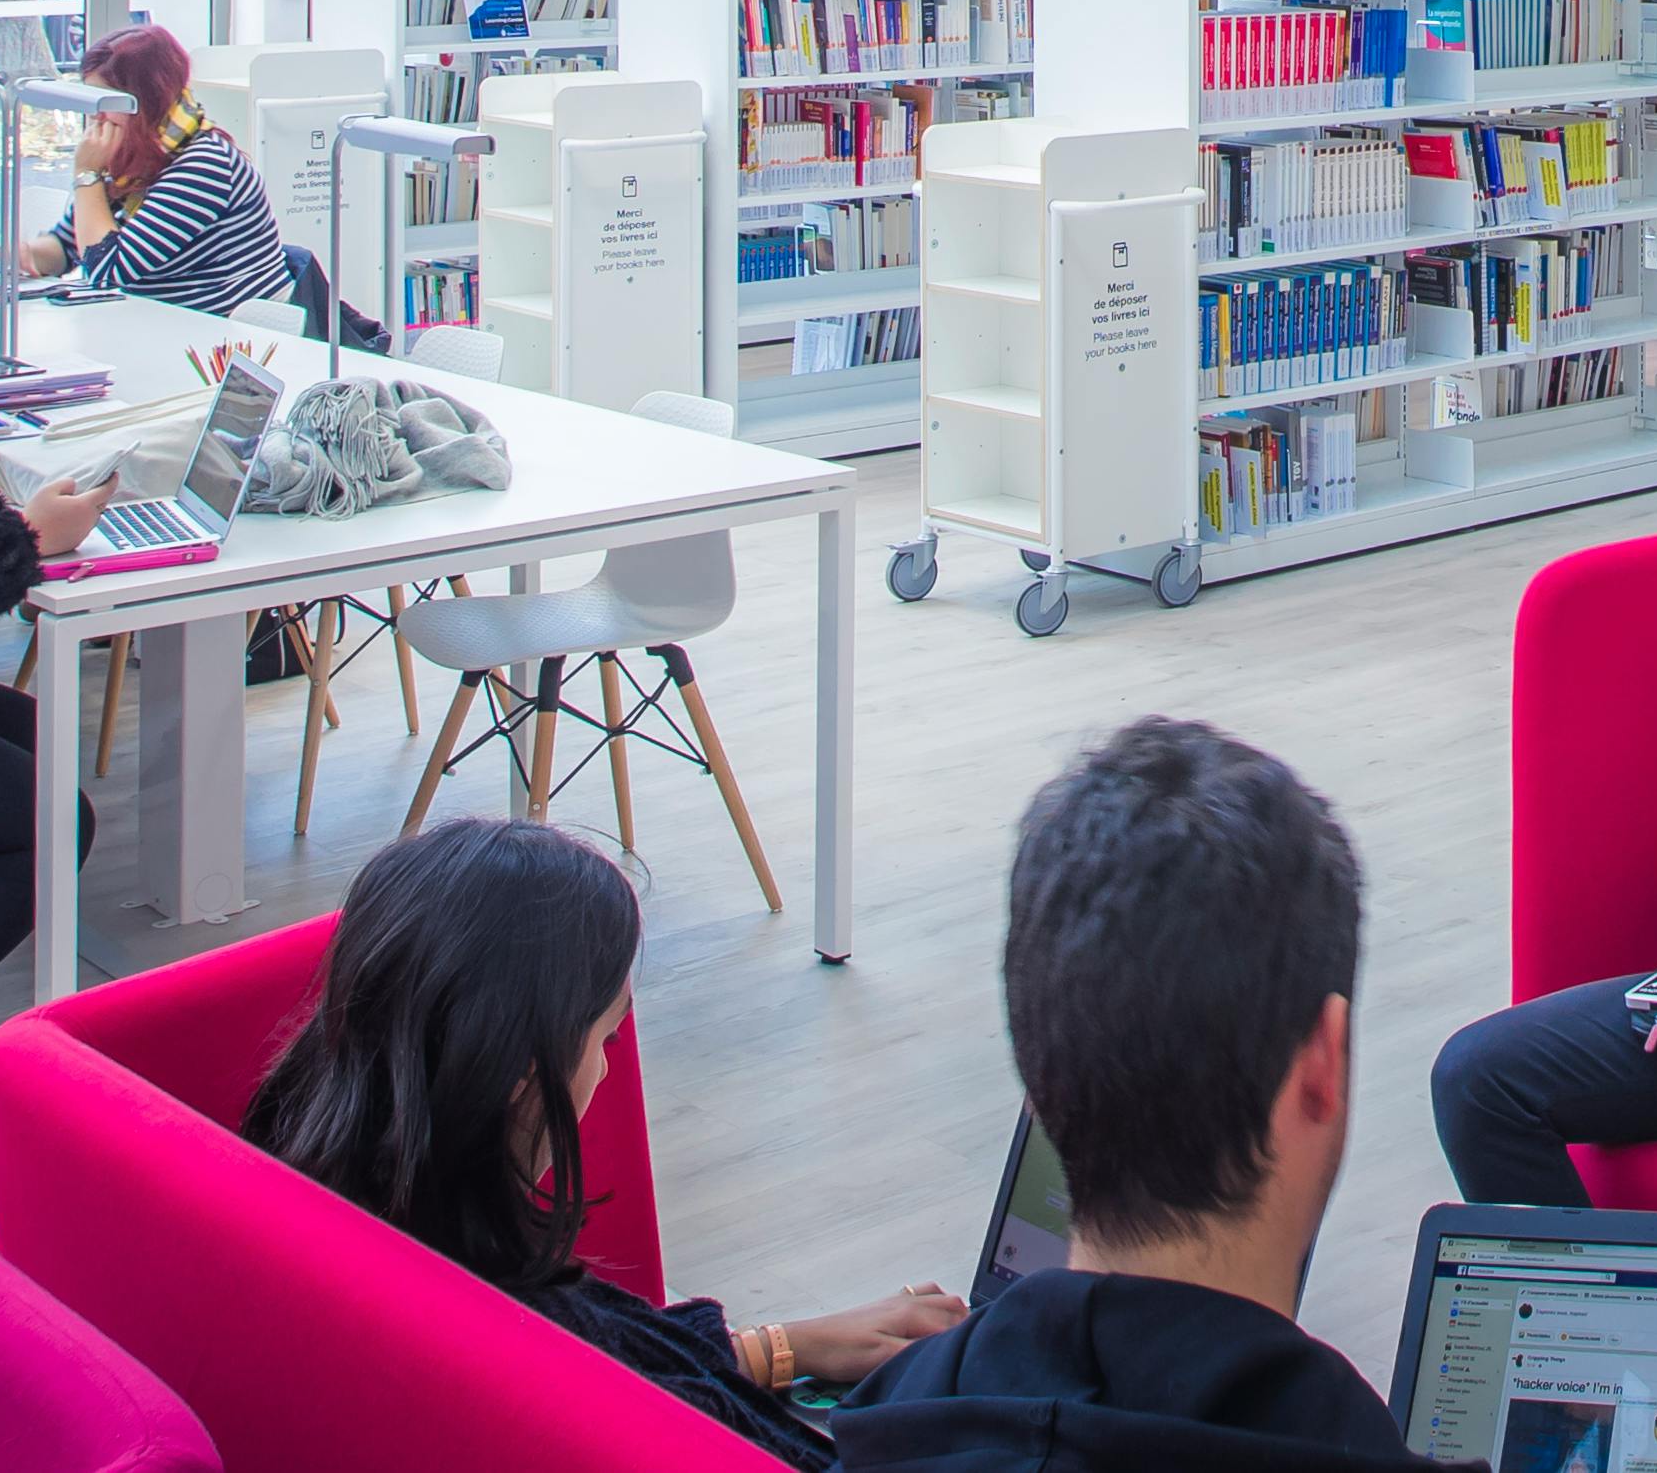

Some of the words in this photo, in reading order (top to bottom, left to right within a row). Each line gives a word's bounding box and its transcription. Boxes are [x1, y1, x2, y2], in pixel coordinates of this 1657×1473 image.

[617, 208, 643, 219] Merci
[603, 223, 615, 232] de
[617, 220, 656, 231] déposer
[601, 235, 618, 244] vos
[620, 233, 645, 243] livres
[647, 231, 658, 240] ici
[602, 249, 632, 259] Please
[634, 247, 657, 257] leave
[594, 263, 614, 274] your
[616, 260, 643, 271] books
[645, 258, 665, 267] here
[1107, 280, 1135, 294] Merci
[1094, 299, 1106, 310] de
[1109, 294, 1147, 309] déposer
[1092, 314, 1109, 324] vos
[1111, 309, 1137, 322] livres
[1139, 306, 1150, 317] ici
[1093, 330, 1123, 343] Please
[1126, 326, 1149, 338] leave
[1085, 347, 1106, 361] your
[1108, 342, 1135, 355] books
[1138, 339, 1157, 351] here
[1448, 408, 1480, 422] Monde
[1293, 462, 1301, 481] TGV
[1593, 1383, 1610, 1395] I'm
[1613, 1383, 1623, 1395] in
